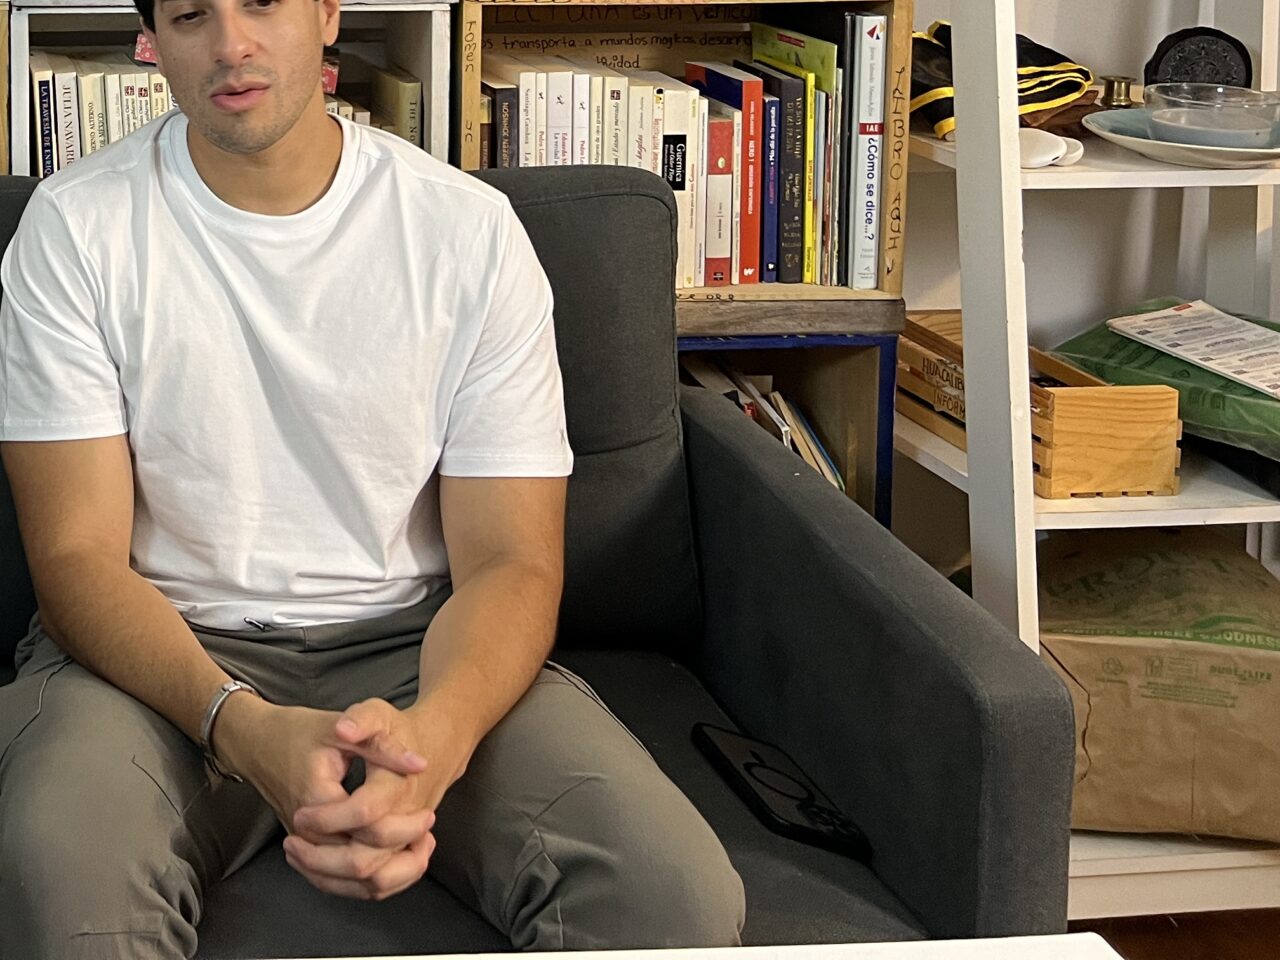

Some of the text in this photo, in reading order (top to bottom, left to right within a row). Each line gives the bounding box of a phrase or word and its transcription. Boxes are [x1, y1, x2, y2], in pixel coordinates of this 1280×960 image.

[599, 34, 648, 47] mundos
[40, 85, 52, 176] LA TRAVESÍA DE ENRIQ
[62, 84, 75, 165] JULIA NAVARR
[675, 143, 685, 182] Guernica
[864, 137, 879, 240] ¿Cómo se dice...?
[921, 357, 965, 391] HUACALIB
[933, 390, 966, 419] INFORM
